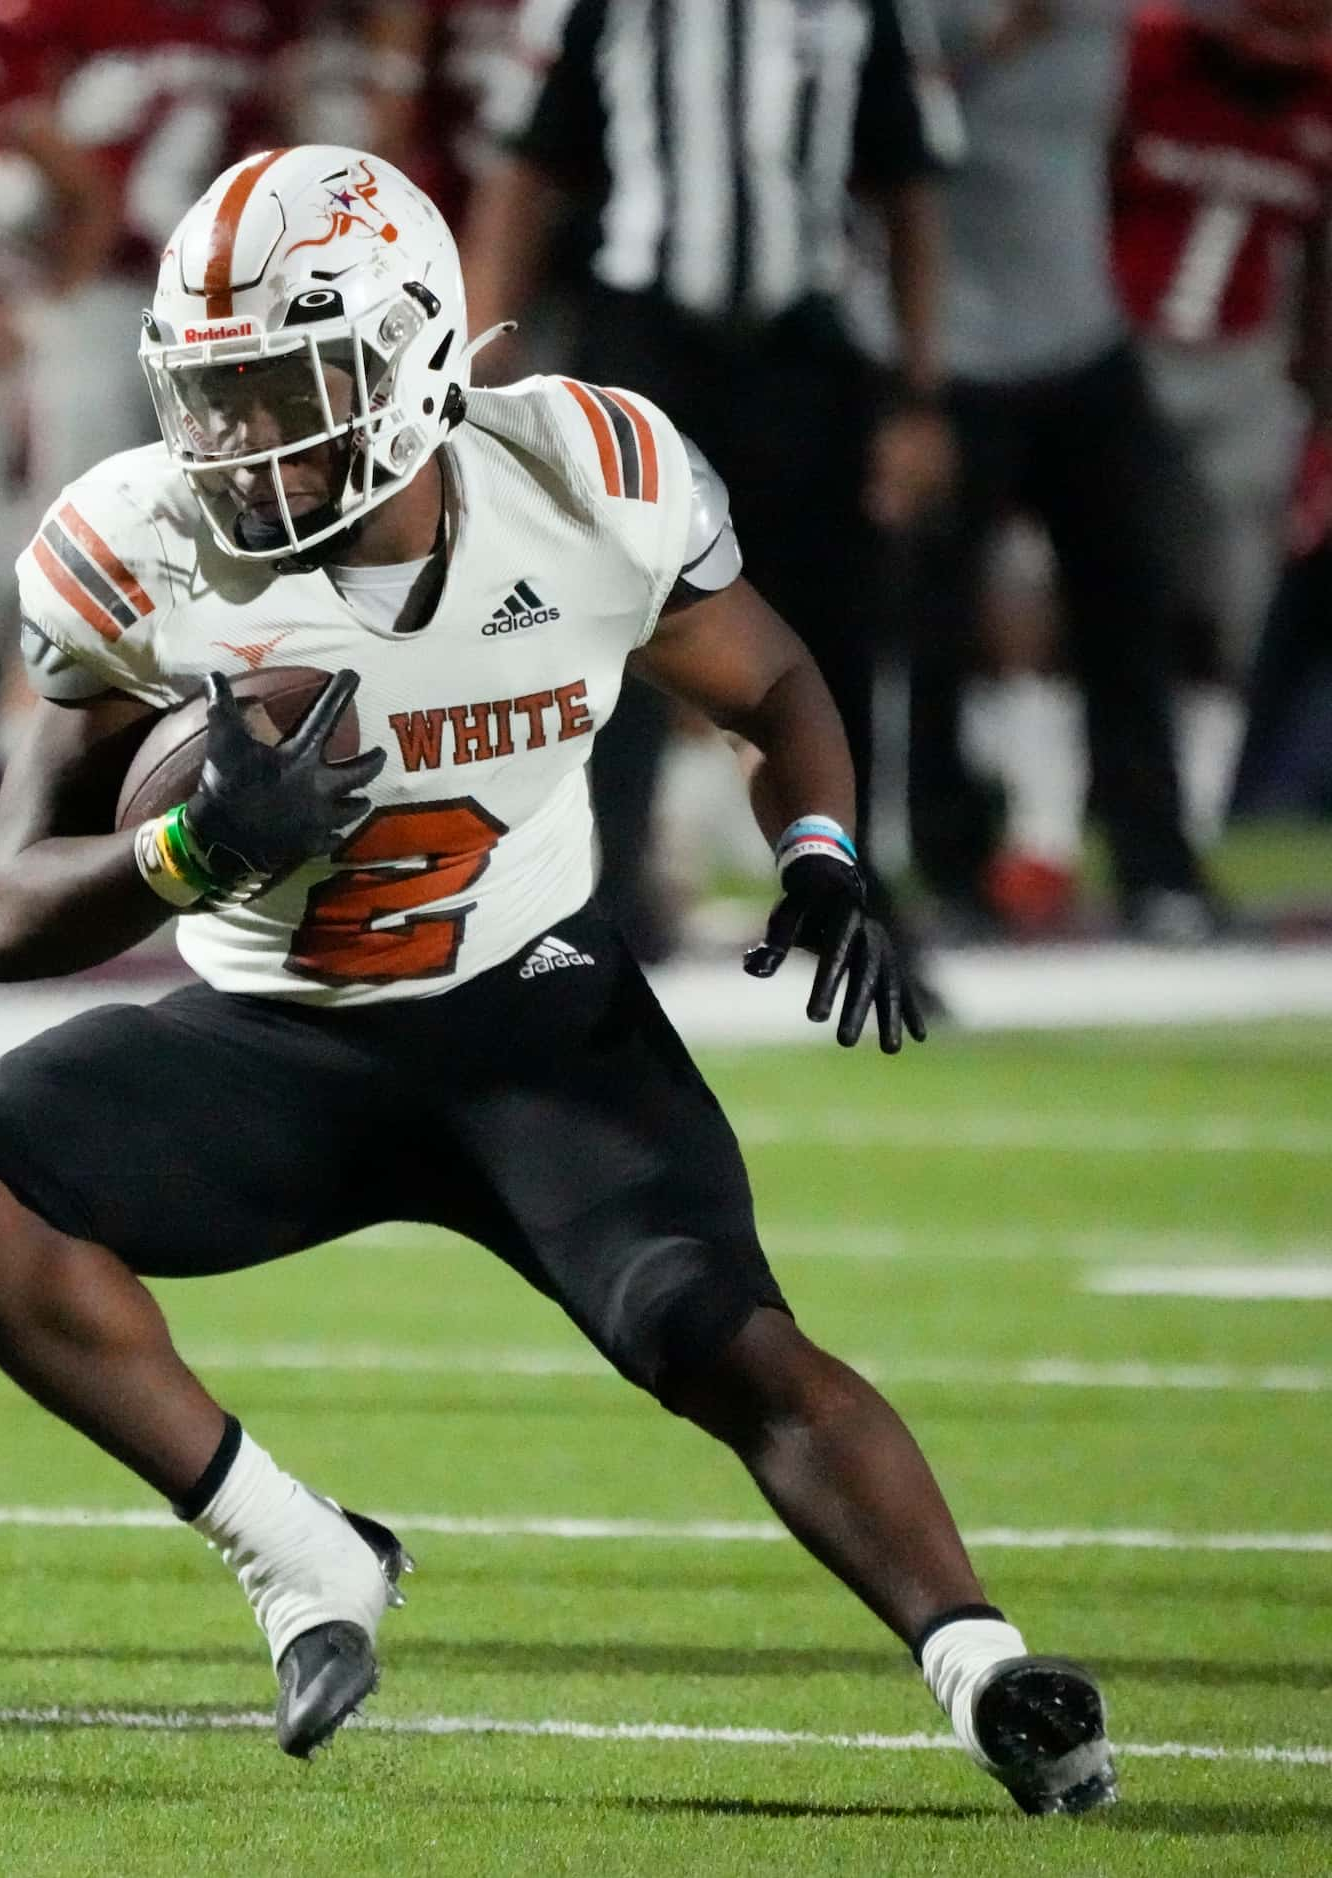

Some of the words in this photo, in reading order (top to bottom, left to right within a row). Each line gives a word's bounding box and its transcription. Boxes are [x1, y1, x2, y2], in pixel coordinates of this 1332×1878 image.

[184, 322, 252, 344] Riddell
[481, 607, 561, 637] adidas
[387, 680, 594, 773] WHITE
[281, 796, 511, 986] 2
[519, 952, 595, 980] adidas
